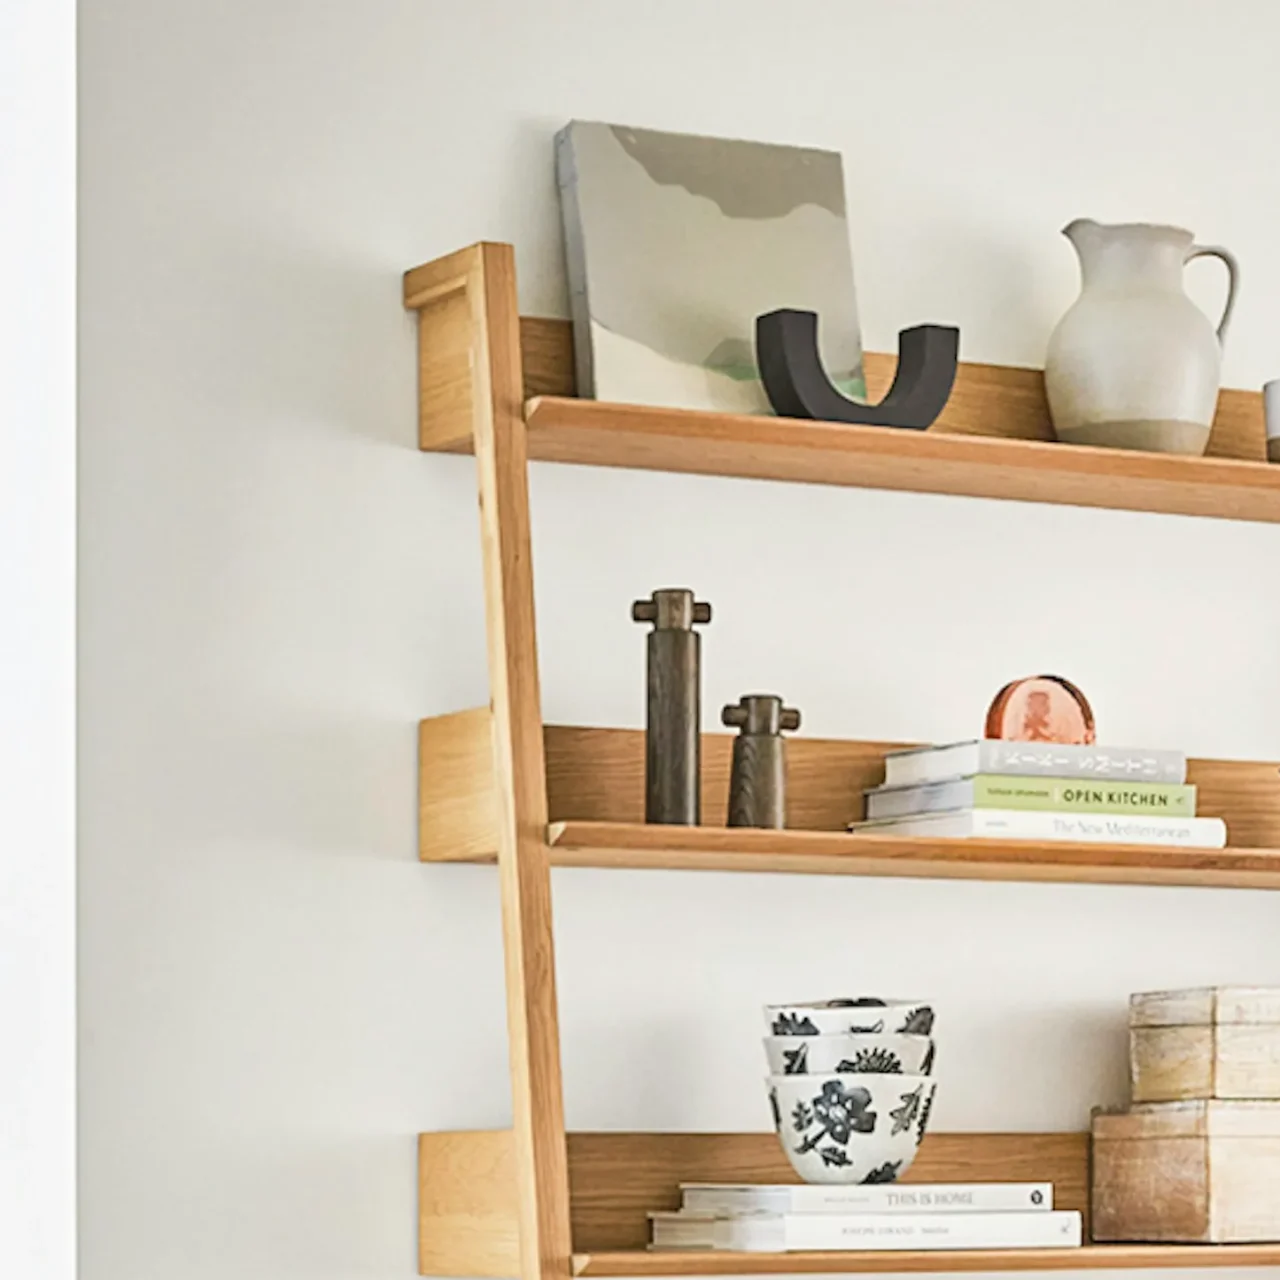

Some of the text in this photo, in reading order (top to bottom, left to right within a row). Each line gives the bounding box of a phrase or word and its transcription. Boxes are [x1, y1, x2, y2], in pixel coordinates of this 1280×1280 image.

[1062, 789, 1102, 804] OPEN
[1107, 790, 1169, 807] KITCHEN
[1053, 818, 1190, 839] The New Mediterranean
[886, 1192, 974, 1206] THIS IS HOME
